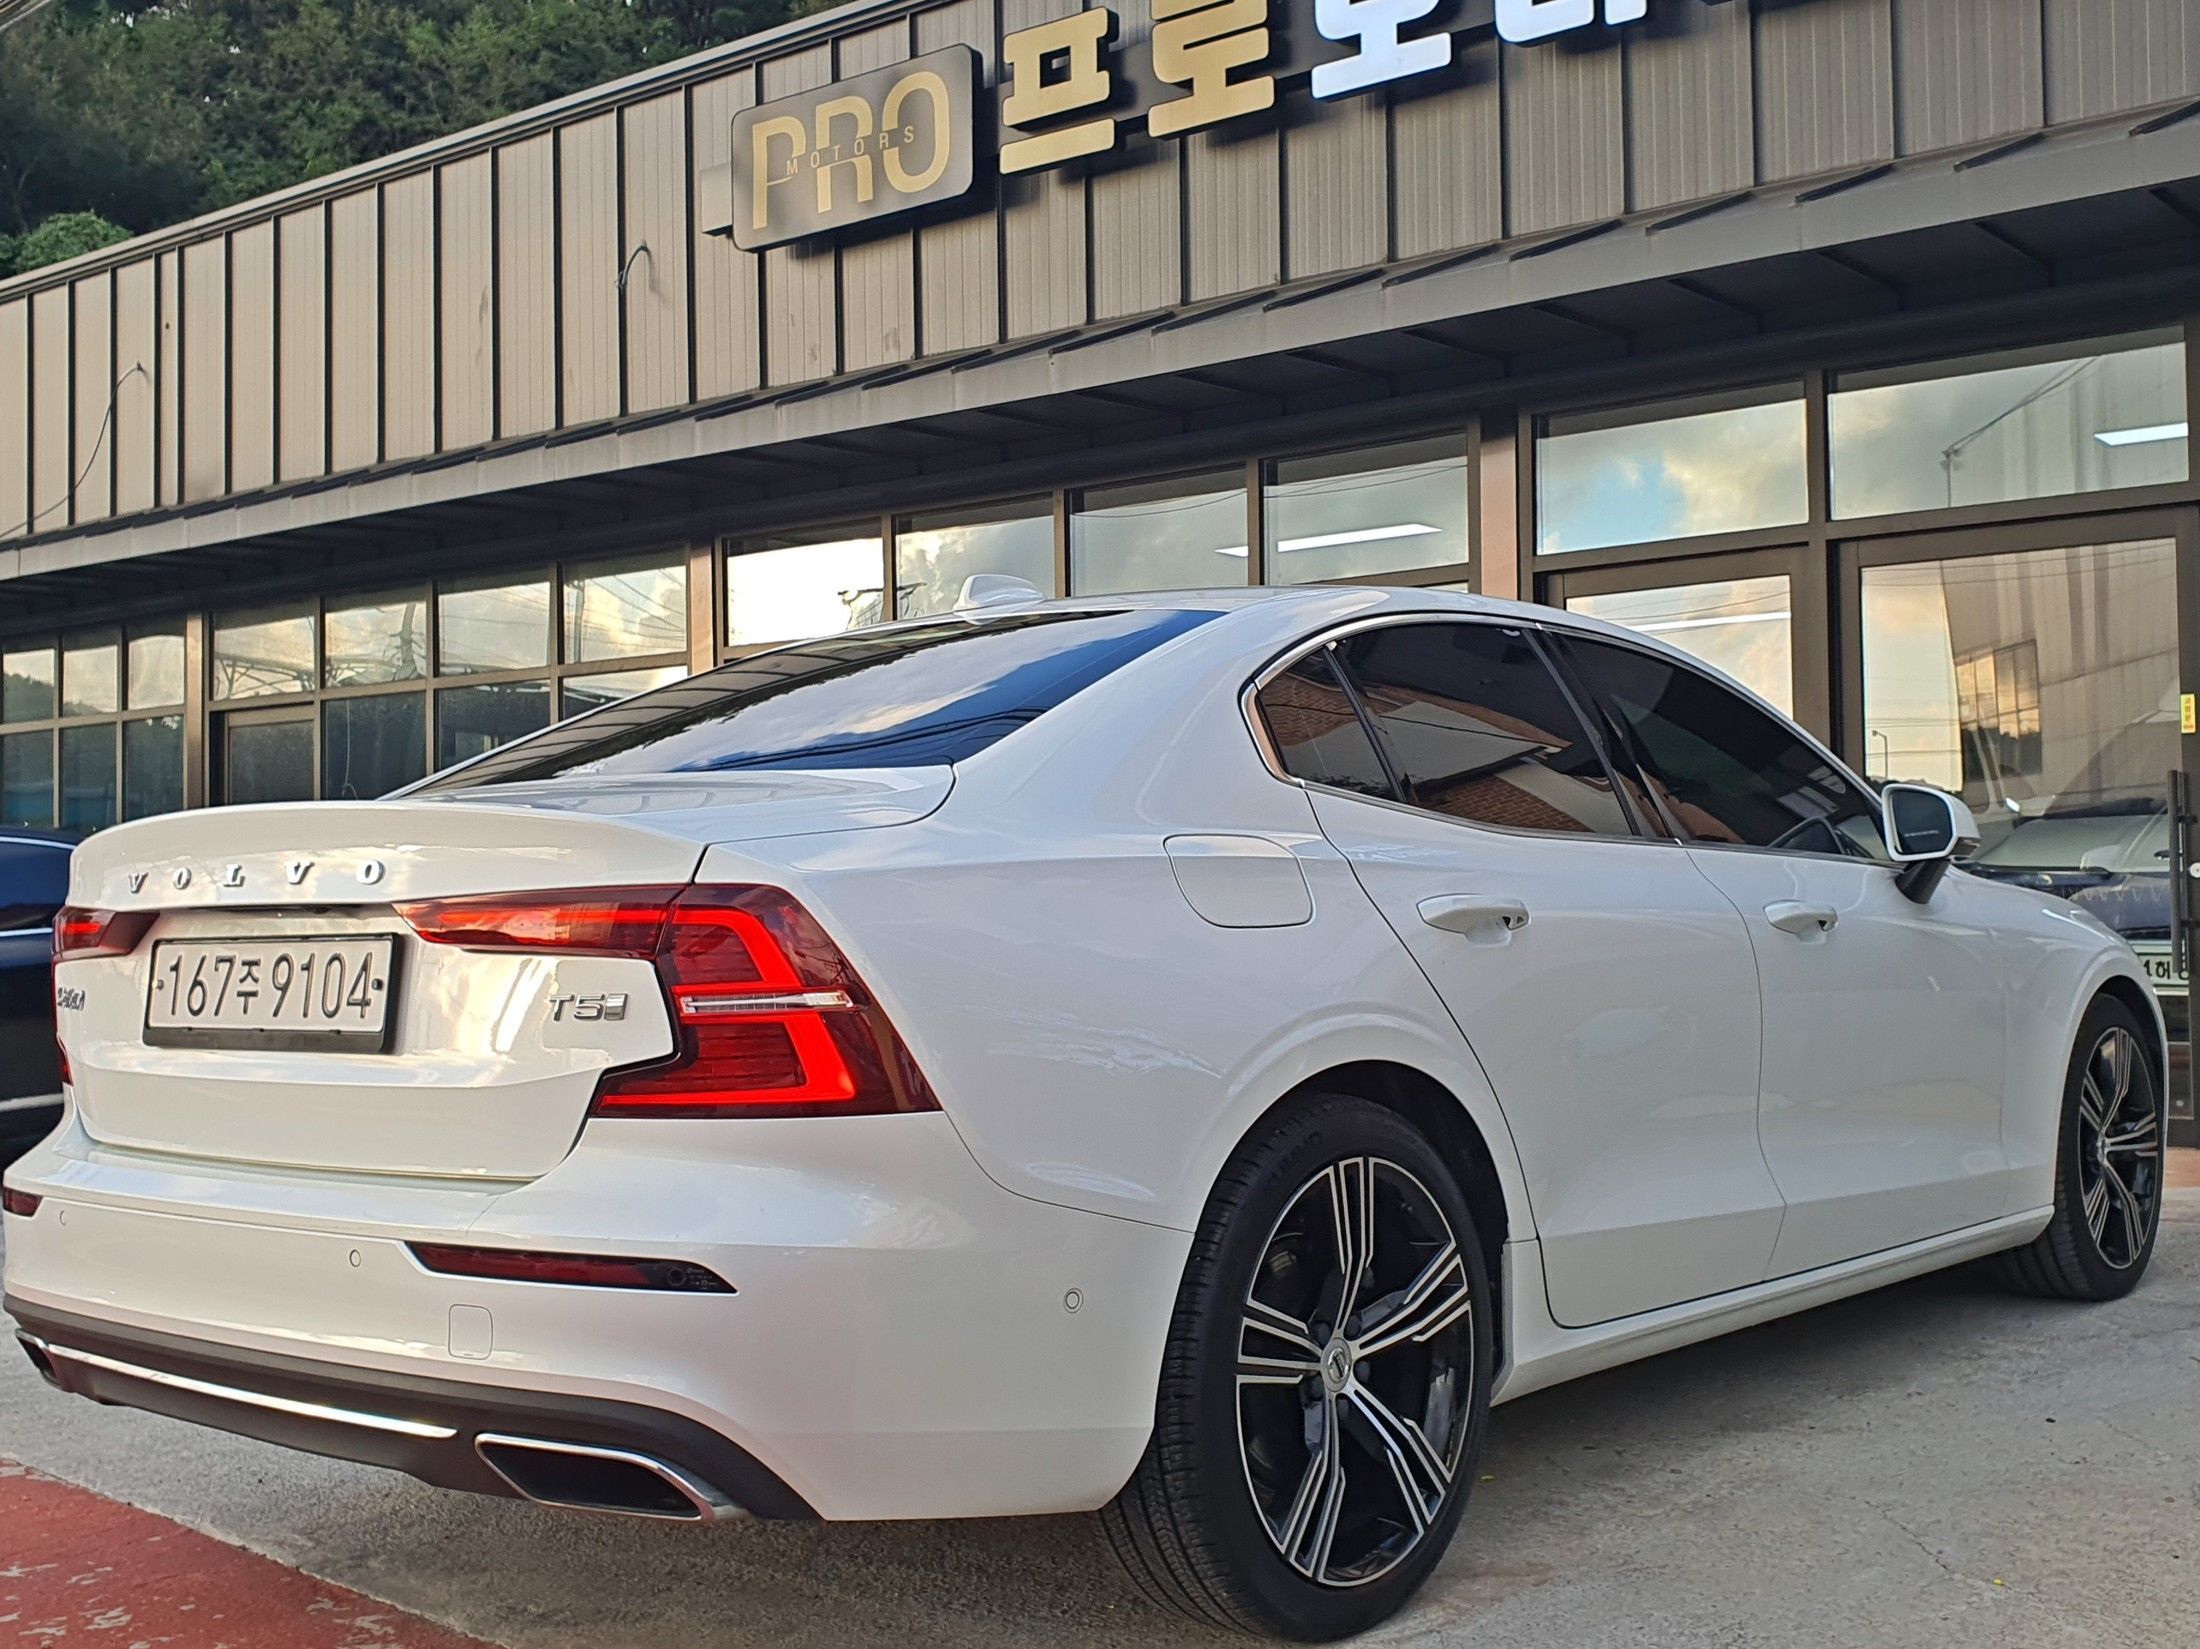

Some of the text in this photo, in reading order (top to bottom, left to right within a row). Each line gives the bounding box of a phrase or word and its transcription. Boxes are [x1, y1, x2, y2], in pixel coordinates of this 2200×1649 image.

[752, 71, 950, 230] PRO
[786, 125, 914, 176] MOTORS
[129, 859, 386, 893] VOLVO
[549, 993, 606, 1021] T5
